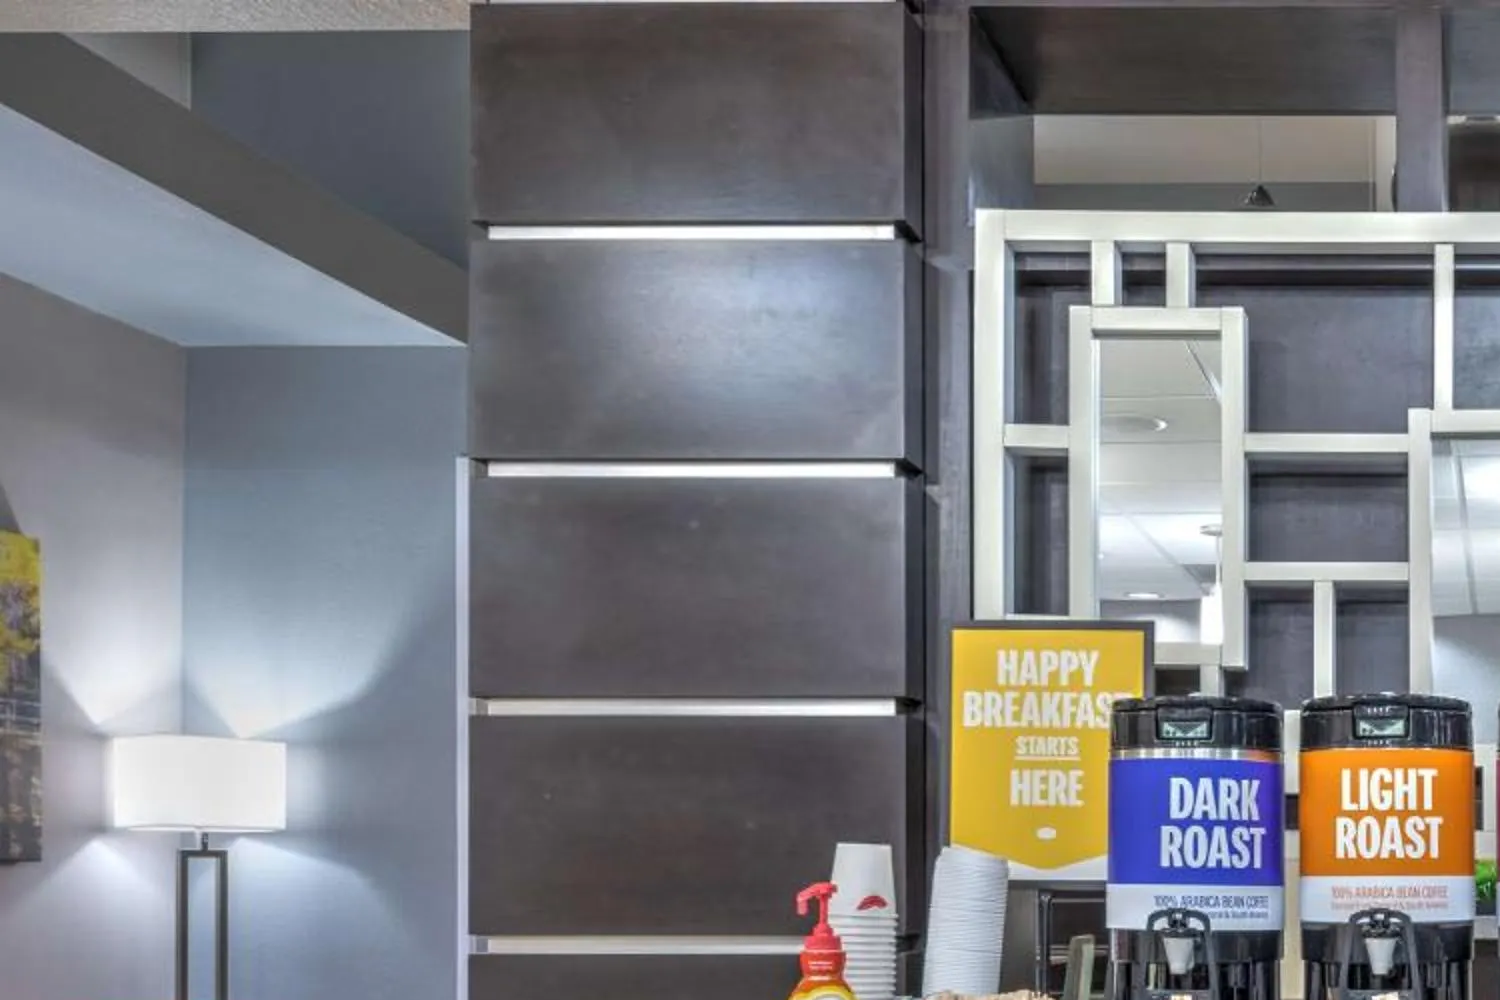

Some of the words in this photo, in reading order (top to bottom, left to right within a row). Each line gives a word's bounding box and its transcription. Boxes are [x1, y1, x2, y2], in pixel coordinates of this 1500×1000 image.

[997, 649, 1099, 687] HAPPY
[963, 690, 1135, 729] BREAKFAS
[1015, 736, 1079, 756] STARTS
[1010, 768, 1085, 807] HERE
[1169, 777, 1261, 820] DARK
[1341, 768, 1438, 810] LIGHT
[1160, 825, 1266, 869] ROAST
[1335, 816, 1444, 859] ROAST
